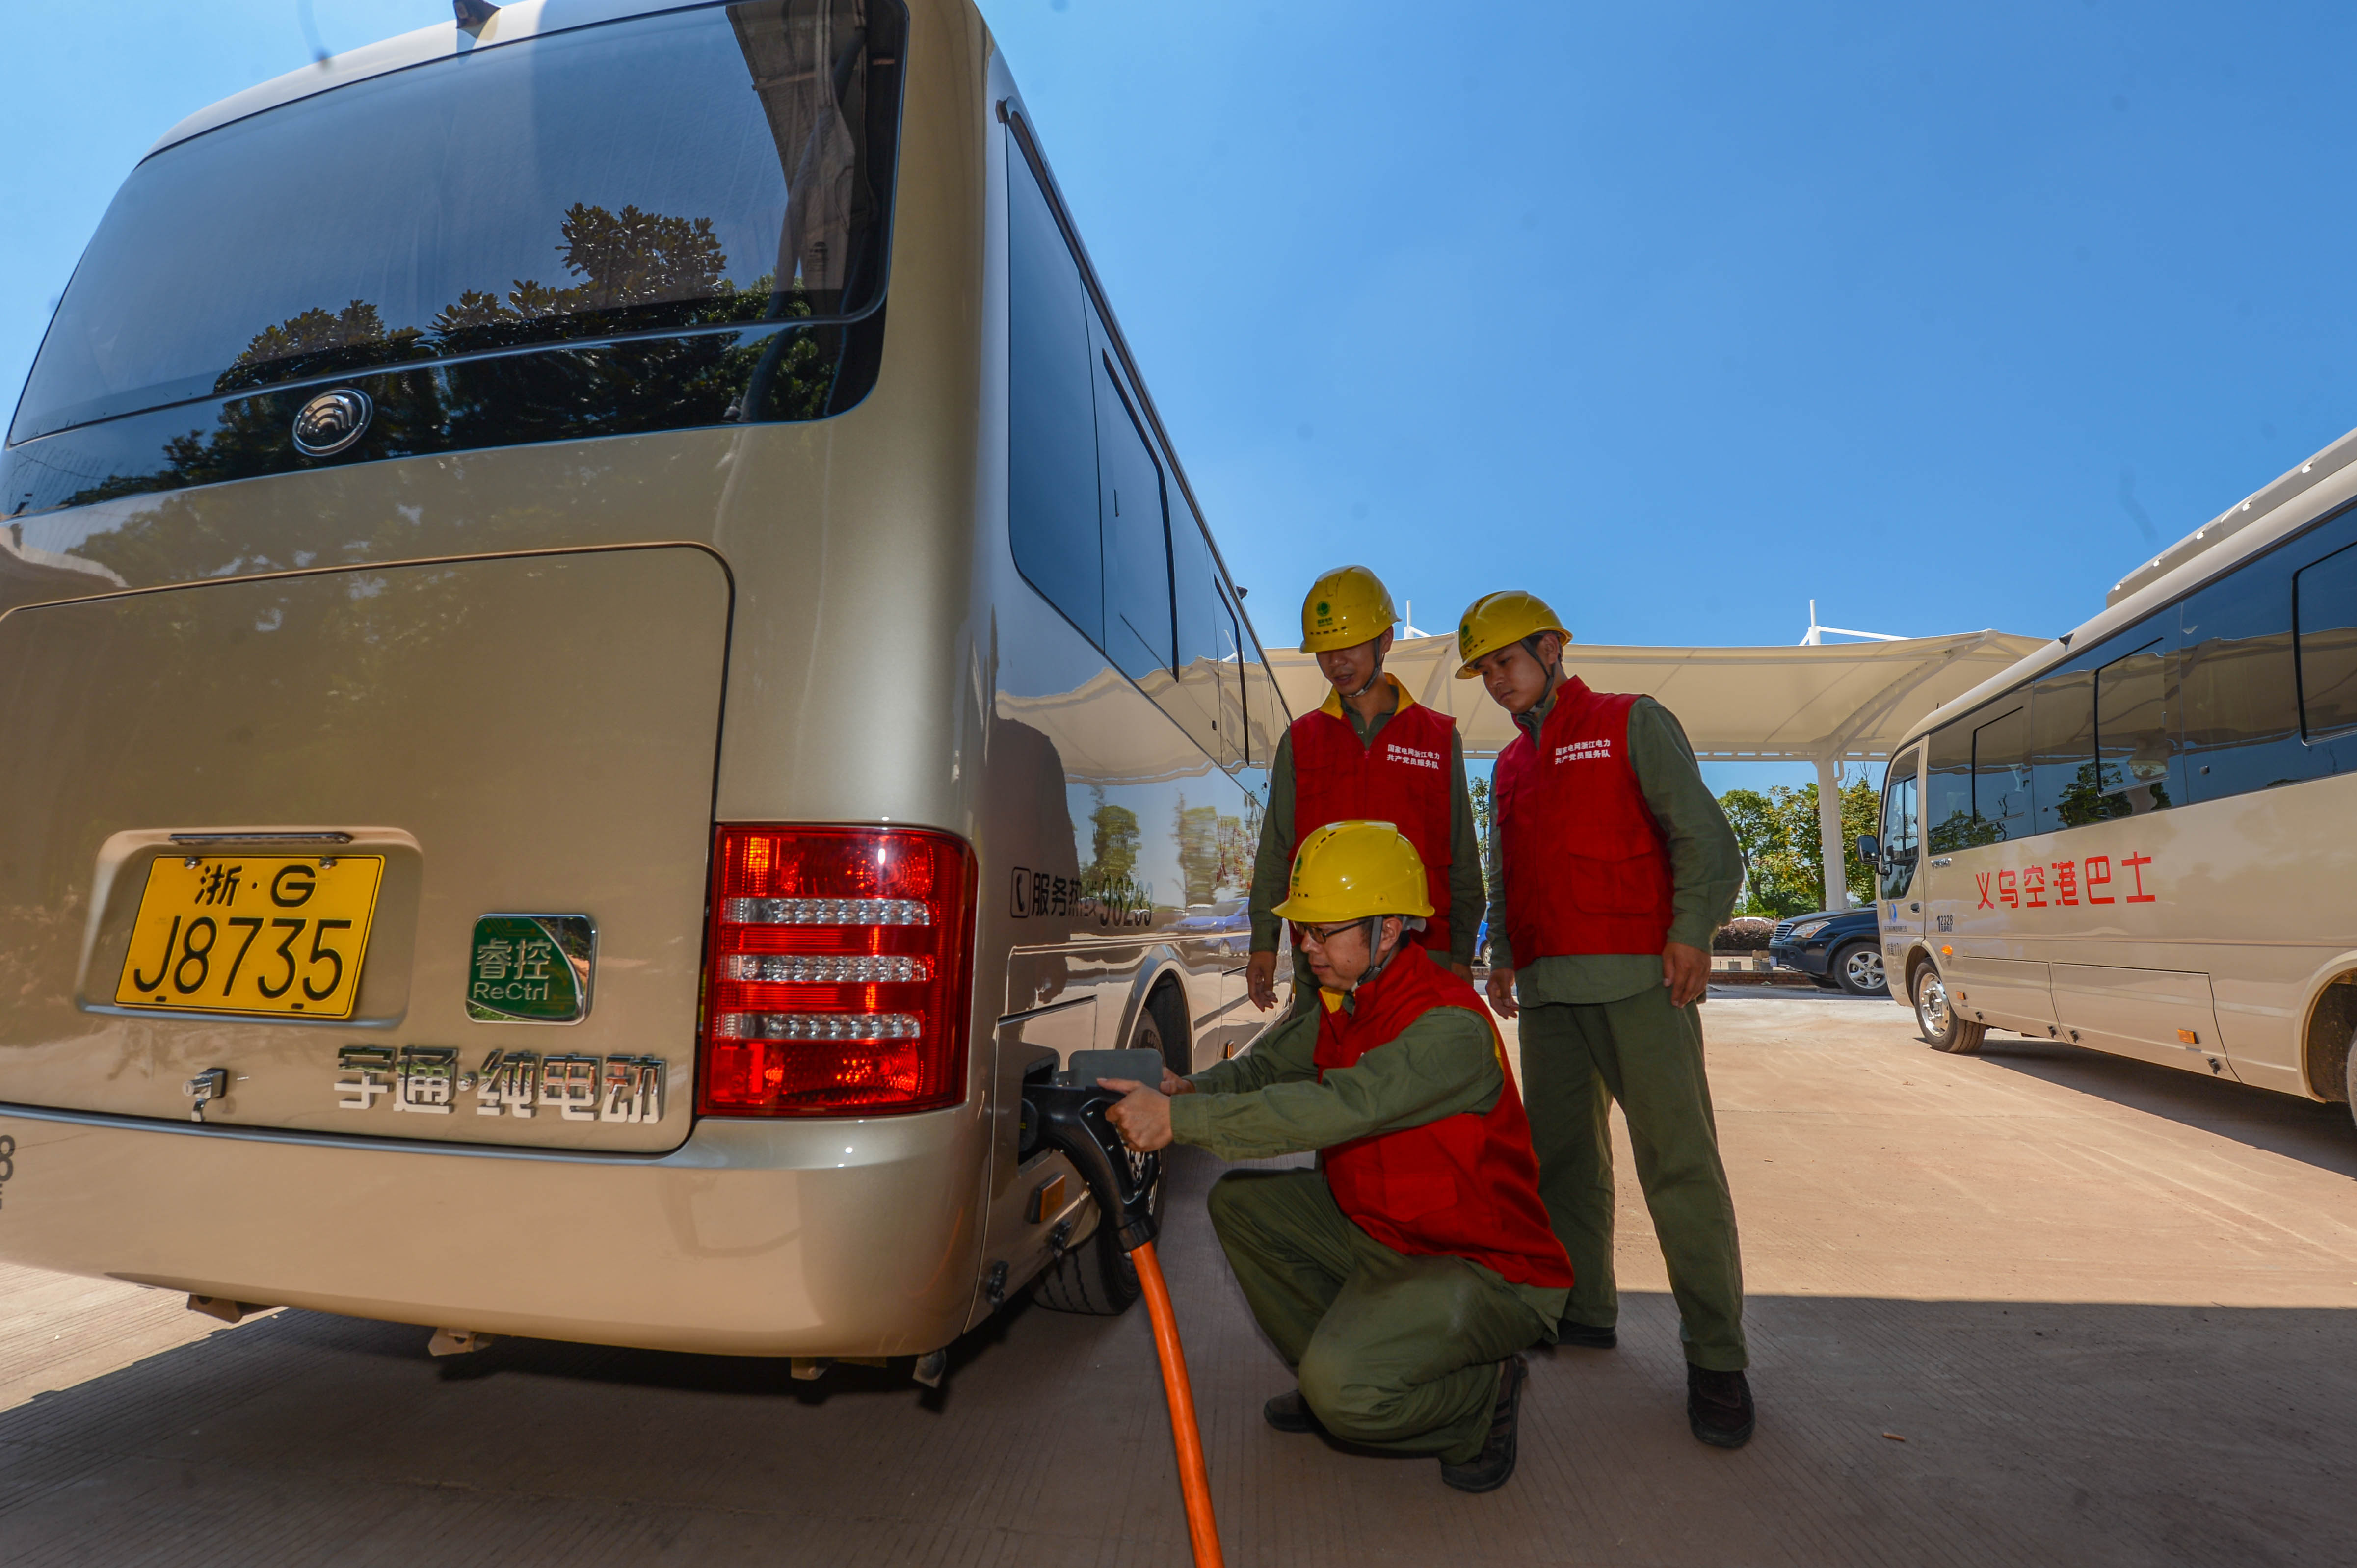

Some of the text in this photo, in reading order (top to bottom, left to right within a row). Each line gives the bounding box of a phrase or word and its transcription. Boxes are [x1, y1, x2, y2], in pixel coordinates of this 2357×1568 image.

[1388, 744, 1440, 760] 国家电网浙江电力
[1555, 738, 1611, 756] 国家电网浙江电力
[1386, 754, 1439, 770] 共产党员服务队
[1555, 749, 1611, 765] 共产党员服务队
[1975, 851, 2156, 910] 义乌空港巴士
[1937, 915, 1954, 932] 12328
[133, 915, 353, 1001] J8735
[476, 938, 552, 980] 睿控
[473, 982, 549, 1001] ReCtrl
